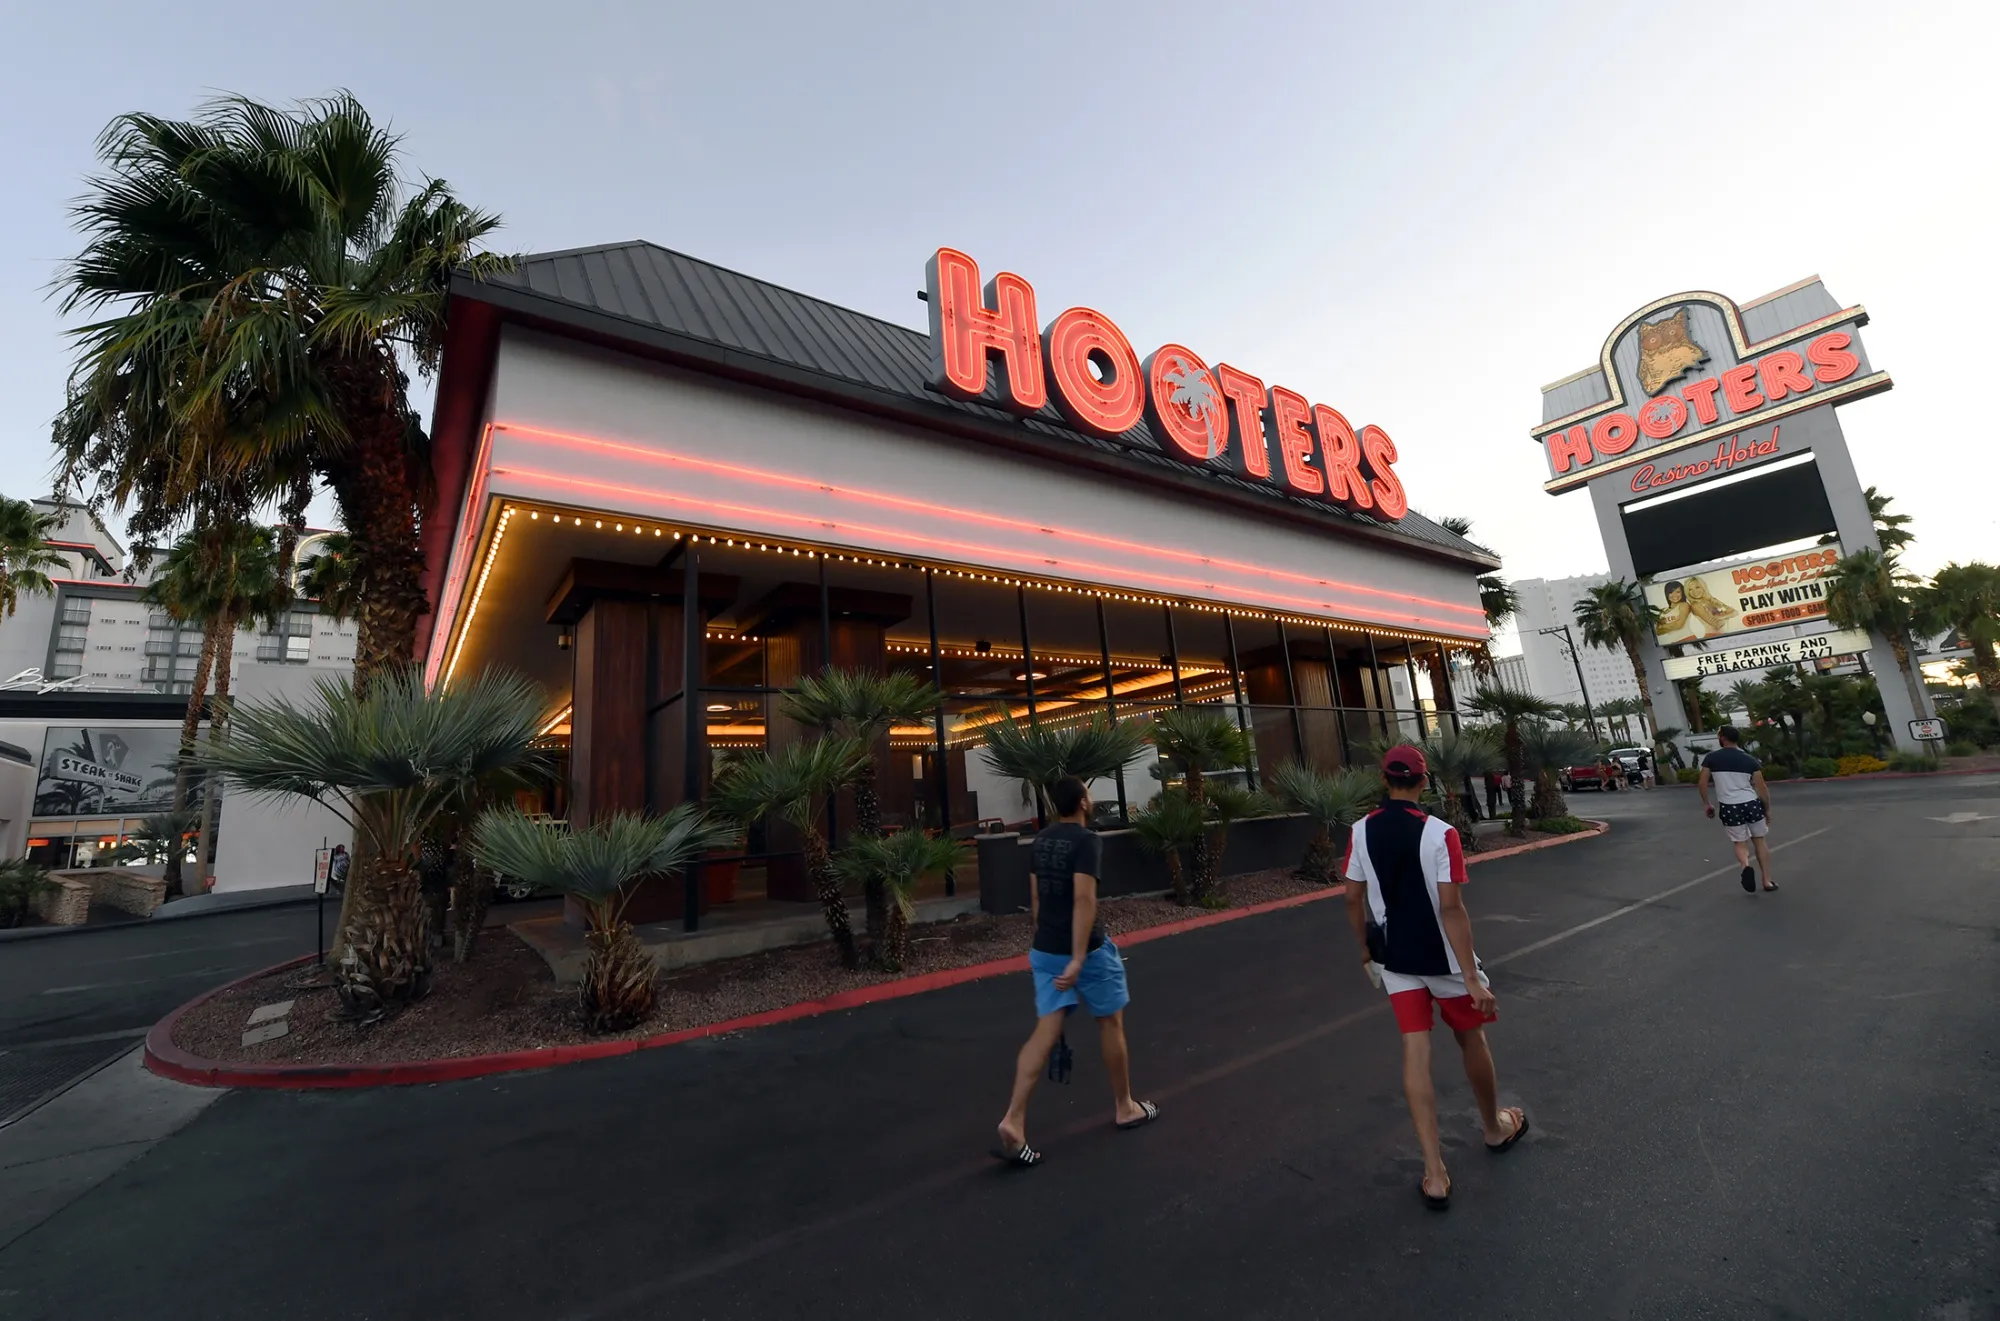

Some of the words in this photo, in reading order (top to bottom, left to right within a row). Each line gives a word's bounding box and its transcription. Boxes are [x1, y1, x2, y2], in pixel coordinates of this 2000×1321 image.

[926, 246, 1408, 522] HOOTERS
[1547, 332, 1860, 473] HOOTERS
[1630, 460, 1709, 493] Casino
[1711, 425, 1780, 470] Hotel
[1731, 549, 1838, 585] HOOTERS
[1740, 591, 1775, 612] PLAY
[1777, 582, 1822, 604] WITH
[1746, 612, 1776, 626] SPORTS
[1781, 607, 1801, 620] FOOD
[1807, 602, 1826, 614] GAM
[1698, 652, 1727, 666] FREE
[1735, 642, 1791, 660] PARKING
[1800, 636, 1828, 649] AND
[1716, 653, 1791, 673] BLACKJACK
[1800, 646, 1832, 660] 24/7
[61, 758, 106, 778] STEAK
[114, 772, 142, 787] SHAKE
